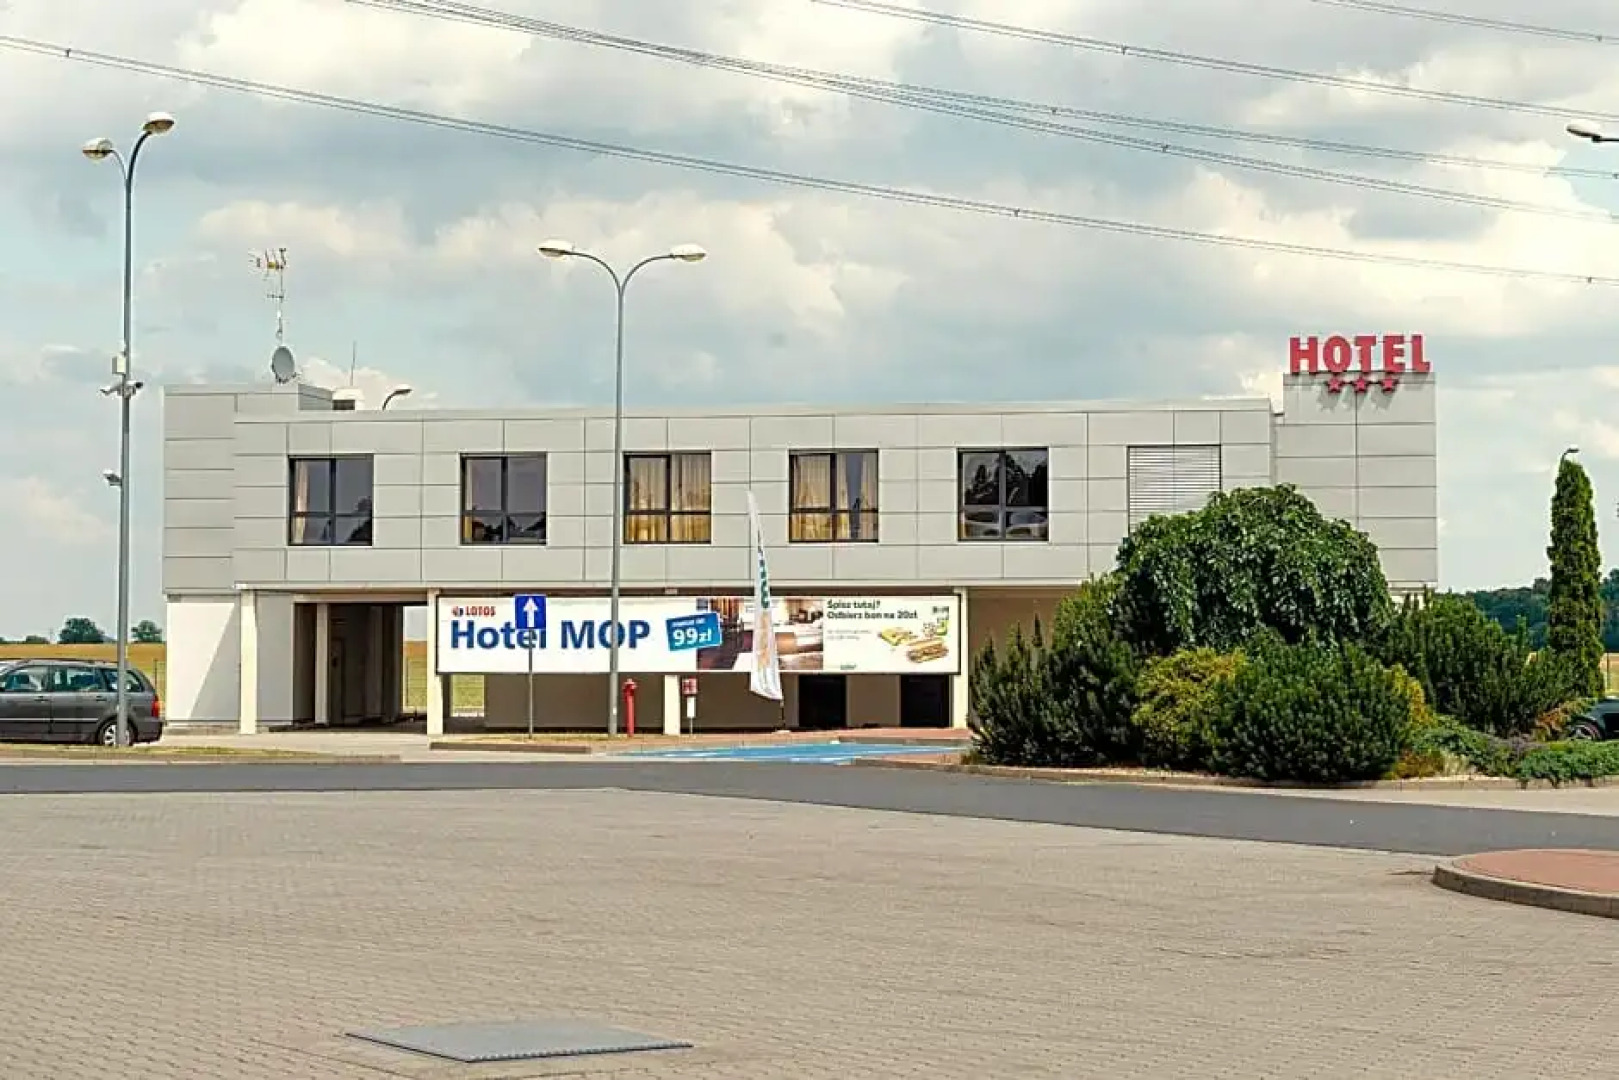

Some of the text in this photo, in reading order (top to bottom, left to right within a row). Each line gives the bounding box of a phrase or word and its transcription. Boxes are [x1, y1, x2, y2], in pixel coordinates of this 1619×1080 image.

[1289, 334, 1431, 373] HOTEL
[853, 600, 881, 610] tutaj?
[466, 606, 496, 616] LOTOS
[827, 610, 862, 619] Odbierz
[864, 610, 882, 619] bon
[451, 620, 650, 649] Hotel MOP
